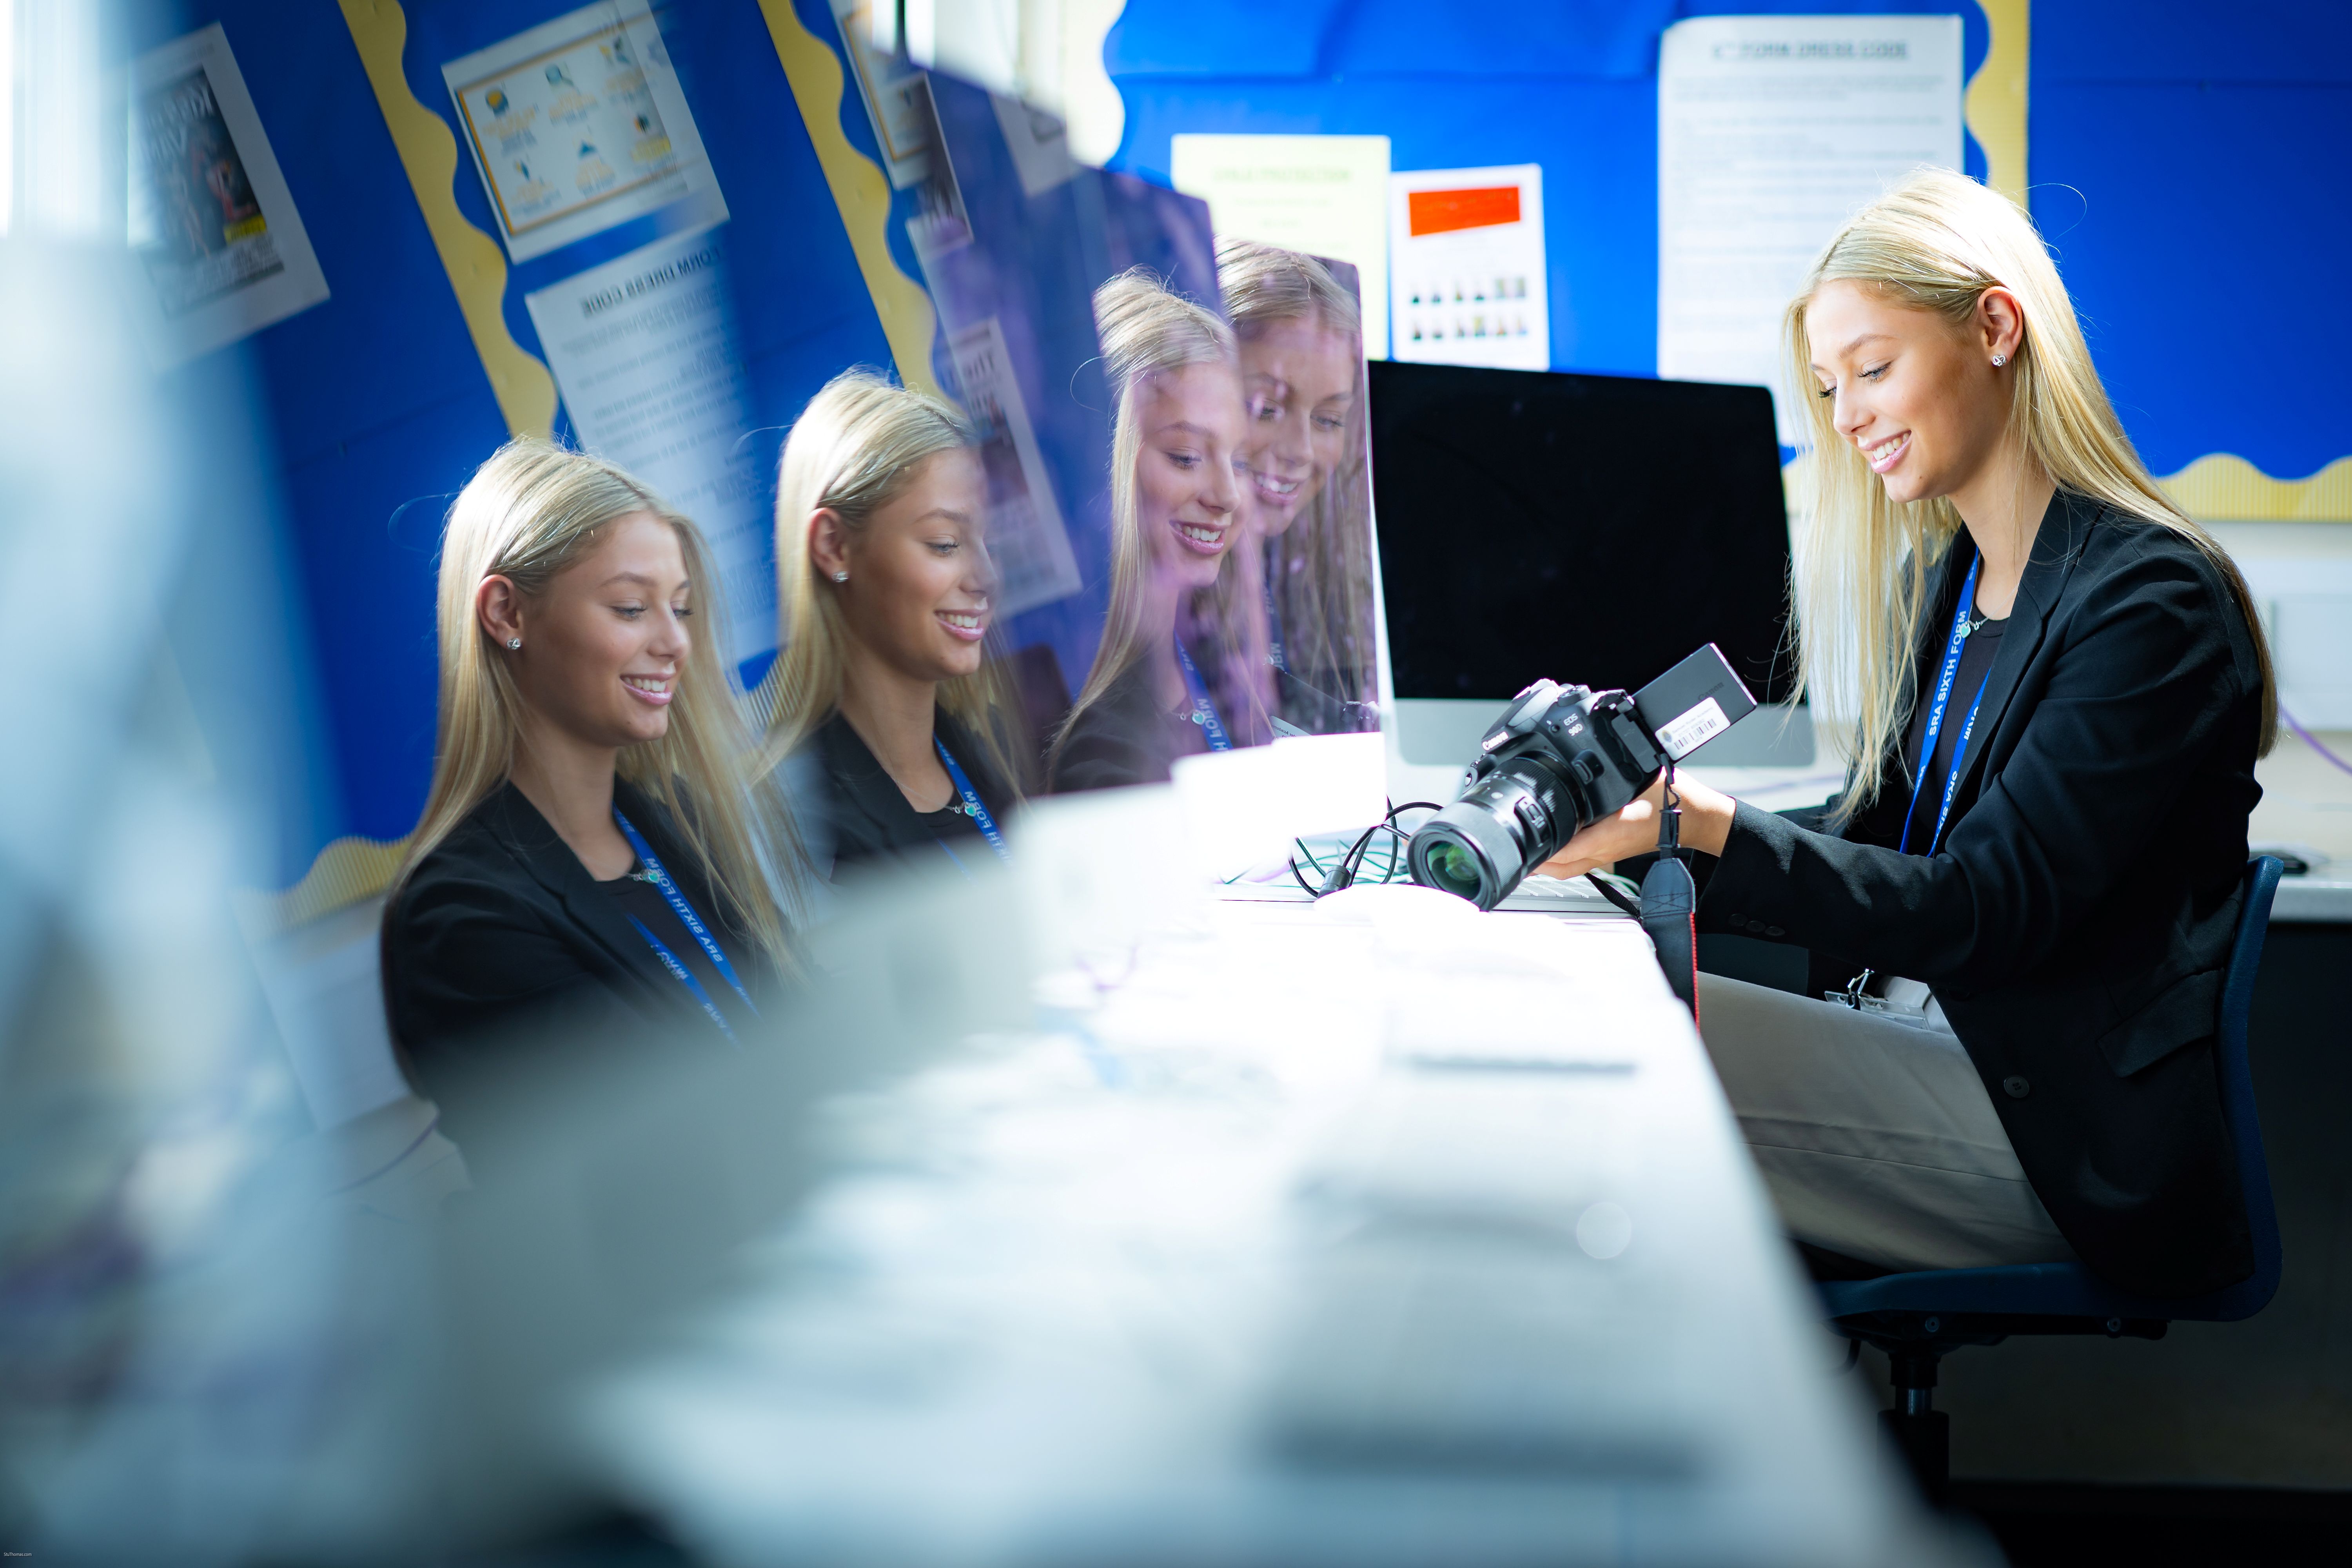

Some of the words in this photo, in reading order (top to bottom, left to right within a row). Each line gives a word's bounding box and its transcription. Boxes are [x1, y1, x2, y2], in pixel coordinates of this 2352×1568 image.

[1698, 682, 1724, 701] Canon
[1929, 704, 1943, 736] SRA
[1937, 659, 1956, 702] SIXTH
[1563, 713, 1579, 726] EOS
[1568, 723, 1583, 736] 90D
[1482, 731, 1508, 751] Canon
